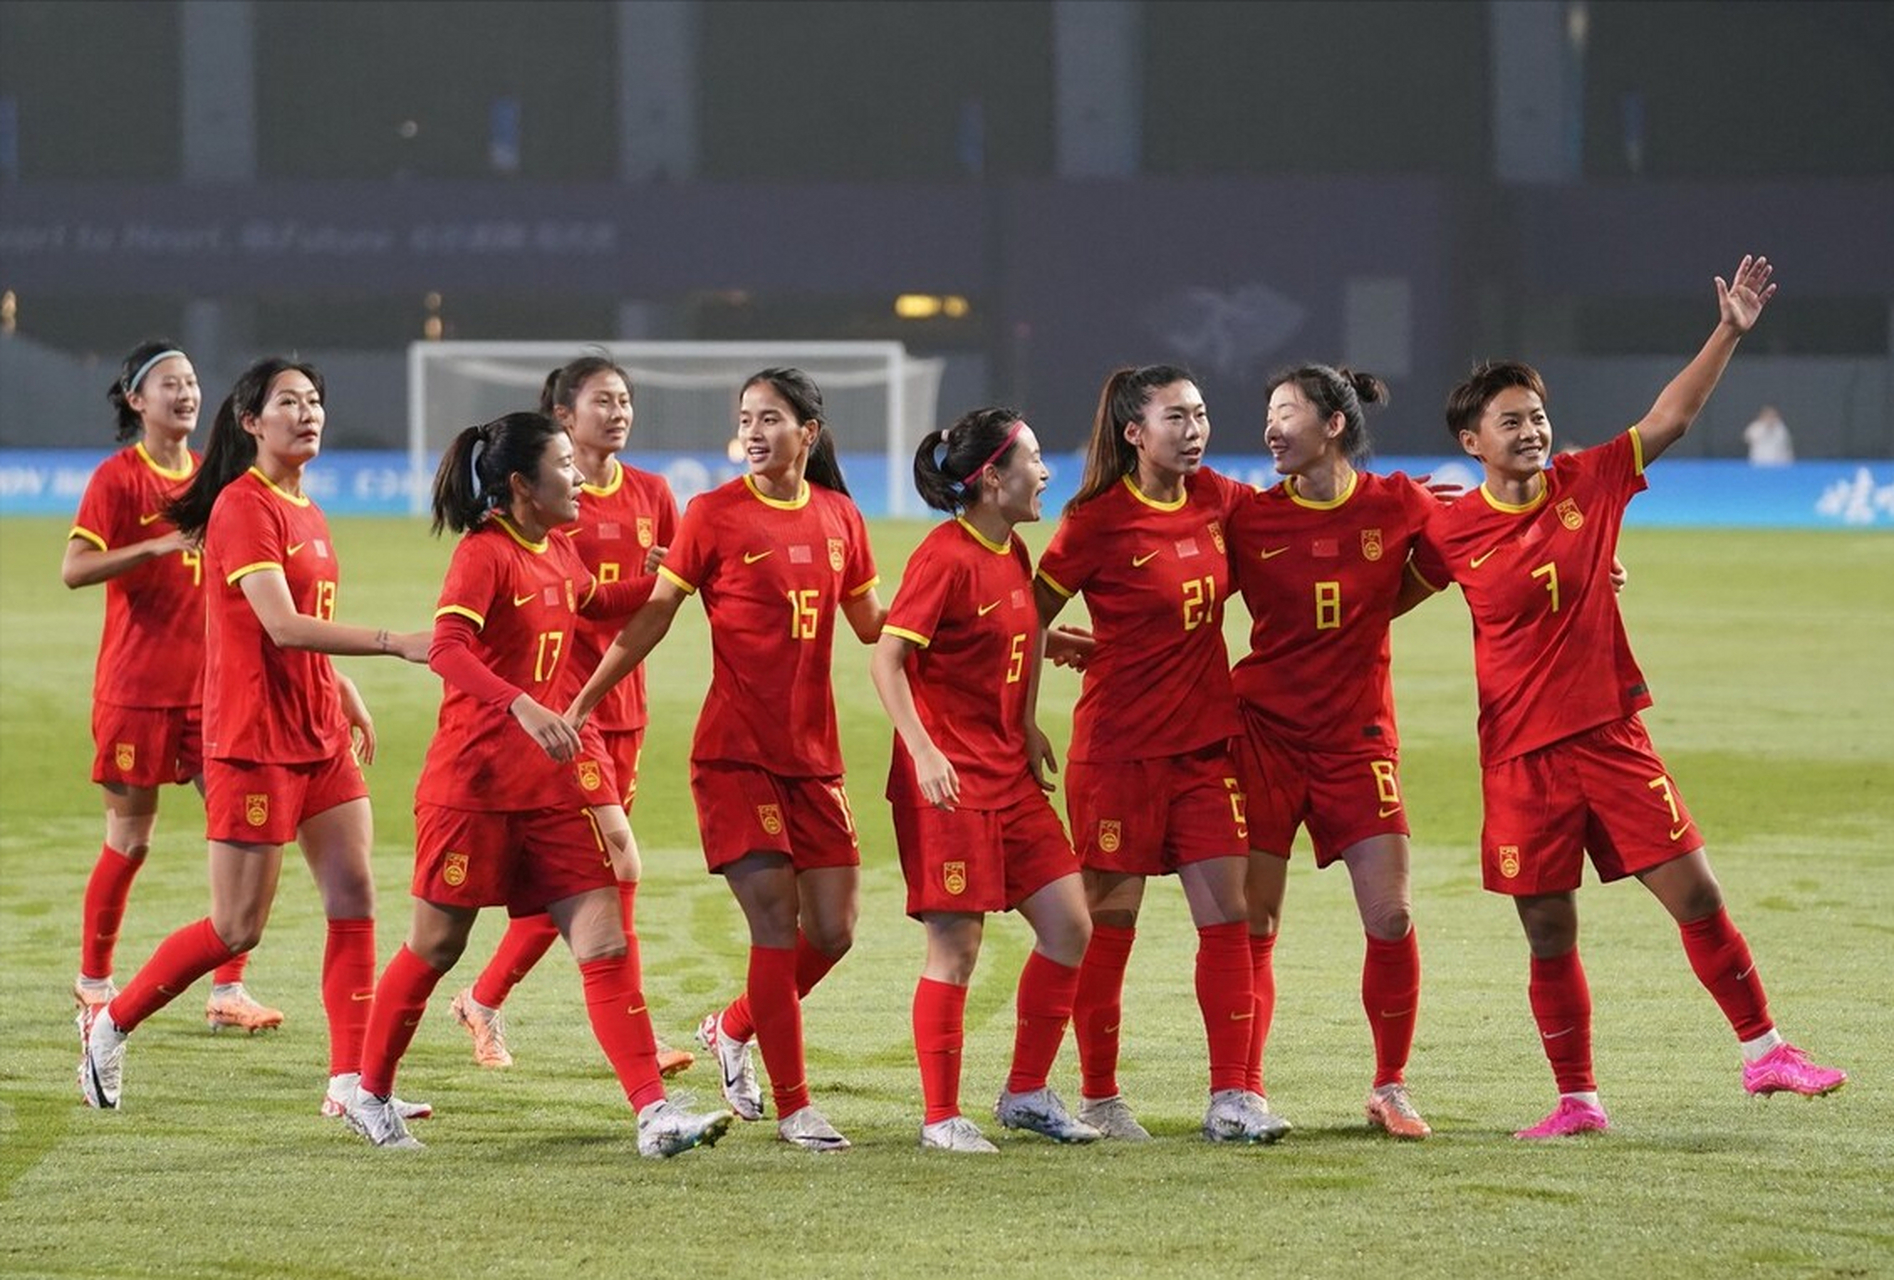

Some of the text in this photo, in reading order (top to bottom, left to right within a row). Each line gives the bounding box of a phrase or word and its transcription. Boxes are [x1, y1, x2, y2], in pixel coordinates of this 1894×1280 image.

[183, 547, 201, 586] 4
[1532, 561, 1558, 612] 7
[316, 580, 336, 622] 13
[787, 589, 819, 639] 15
[1183, 575, 1217, 630] 21
[1315, 581, 1340, 629] 8
[534, 631, 564, 682] 17
[1006, 633, 1026, 684] 5
[1371, 761, 1400, 802] 8
[1649, 775, 1680, 823] 7
